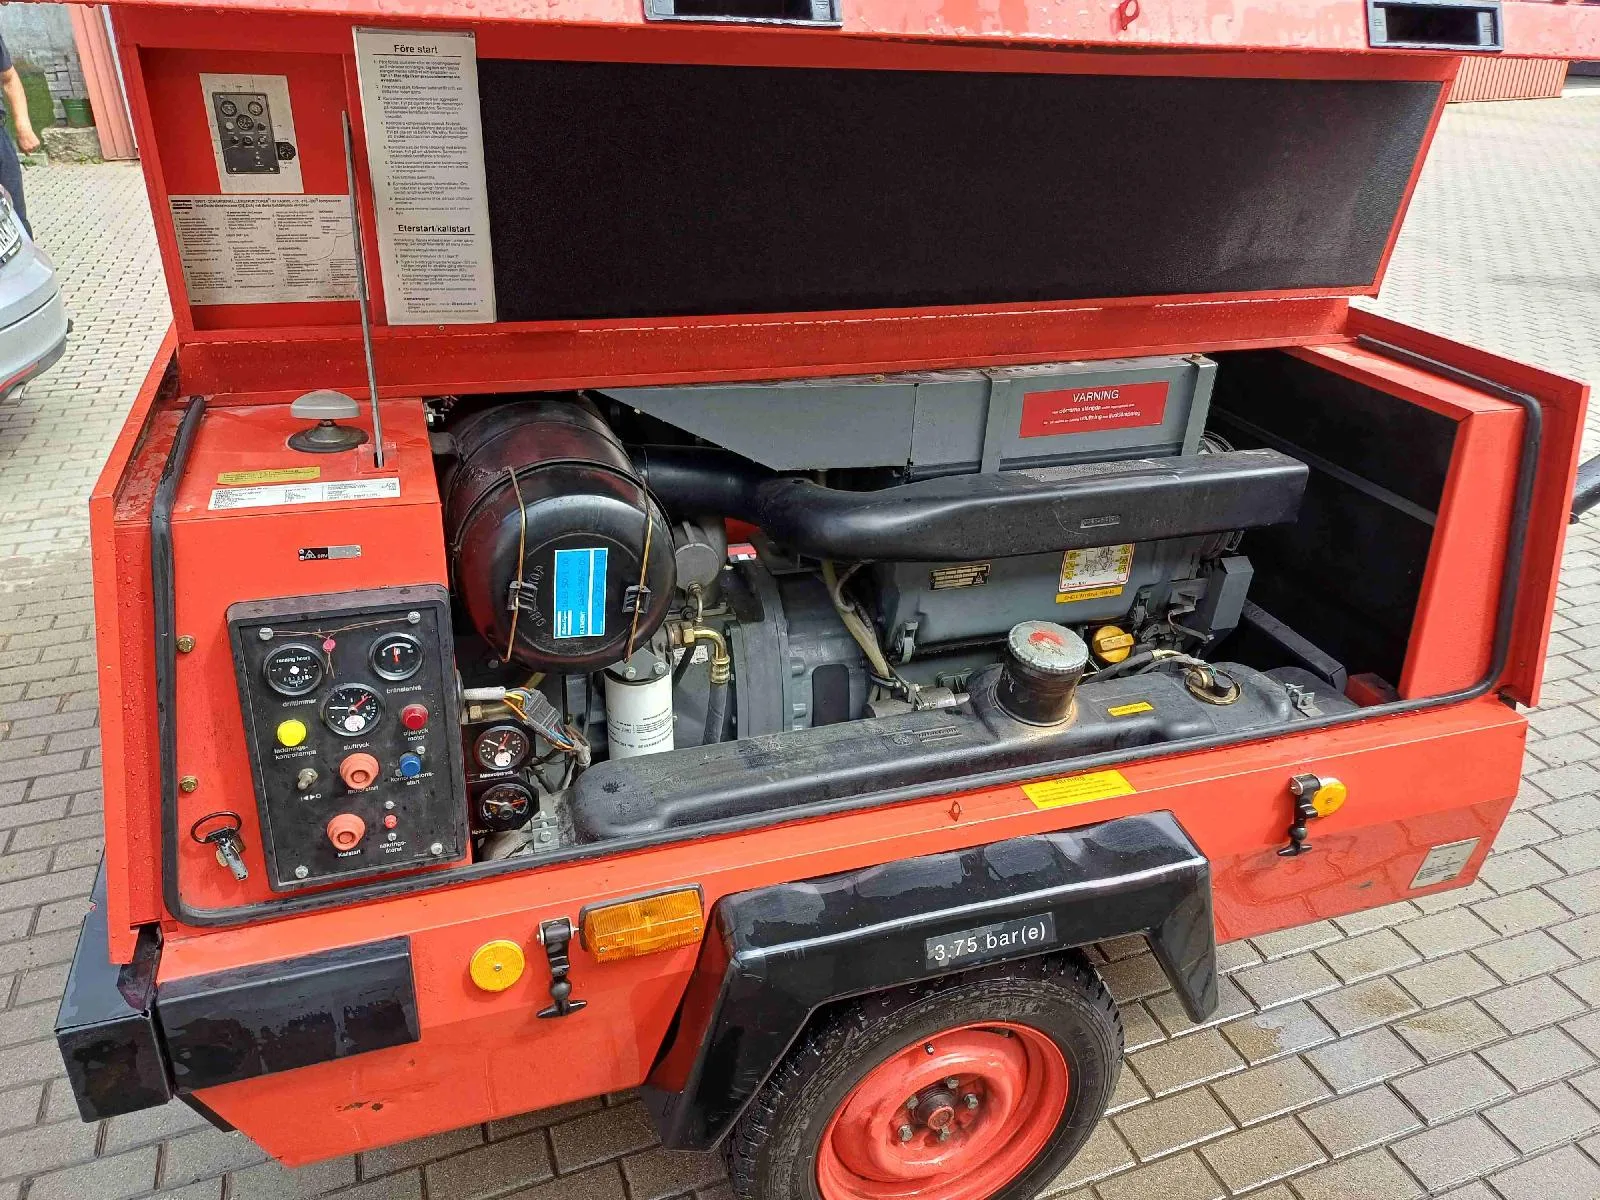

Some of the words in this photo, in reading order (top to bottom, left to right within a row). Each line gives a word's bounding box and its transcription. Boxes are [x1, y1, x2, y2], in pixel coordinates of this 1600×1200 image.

[394, 44, 415, 53] Före
[417, 45, 438, 54] start
[398, 224, 471, 233] Eterstart/kallstart
[1073, 390, 1120, 402] VARNING
[934, 936, 978, 961] 3.75
[986, 921, 1046, 950] bar(e)
